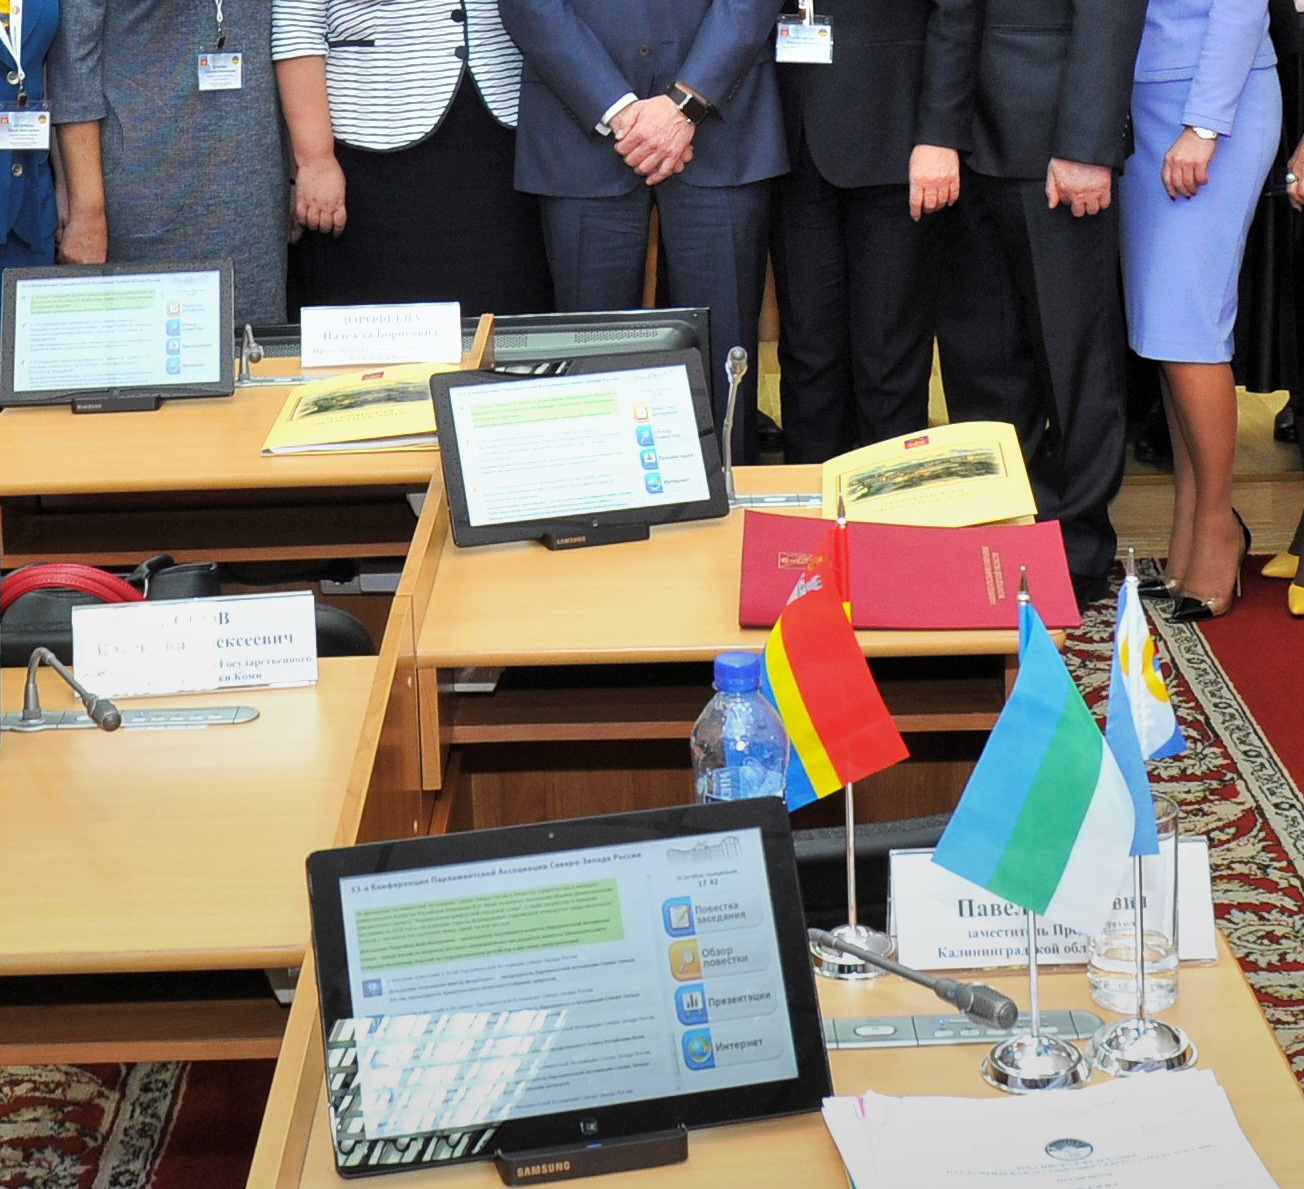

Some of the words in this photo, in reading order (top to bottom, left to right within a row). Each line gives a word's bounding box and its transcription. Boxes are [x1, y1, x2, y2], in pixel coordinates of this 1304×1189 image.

[694, 901, 740, 915] Повестка
[697, 910, 747, 926] заседания
[702, 946, 734, 960] Обзор
[938, 942, 1060, 959] Калининградкой
[703, 954, 749, 968] повестки
[708, 990, 772, 1007] Презентации
[715, 1037, 764, 1052] Интернет
[517, 1160, 571, 1178] SAMSUNG
